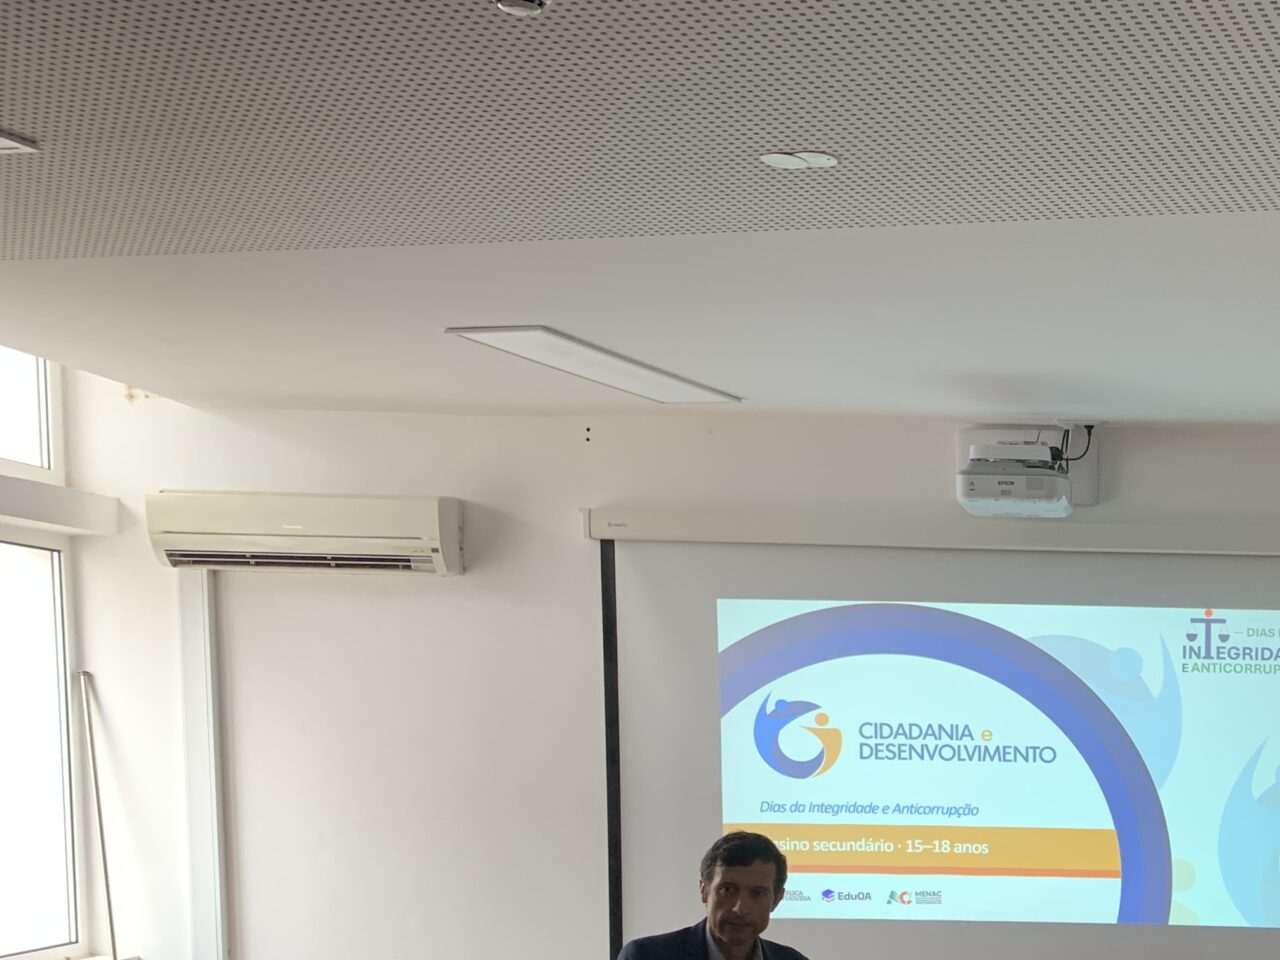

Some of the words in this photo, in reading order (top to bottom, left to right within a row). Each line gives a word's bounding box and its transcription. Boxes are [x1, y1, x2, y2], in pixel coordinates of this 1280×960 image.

[1246, 627, 1275, 638] DIAS
[1182, 663, 1189, 673] E
[859, 722, 975, 741] CIDADANIA
[981, 729, 993, 742] e
[859, 743, 1057, 763] DESENVOLVIMENTO
[760, 801, 787, 813] Dias
[789, 801, 806, 813] da
[808, 801, 879, 816] Integridade
[882, 805, 890, 814] e
[892, 802, 979, 818] Anticorrupção
[813, 837, 894, 852] secundário
[954, 842, 989, 854] anos
[837, 891, 872, 901] EduQA
